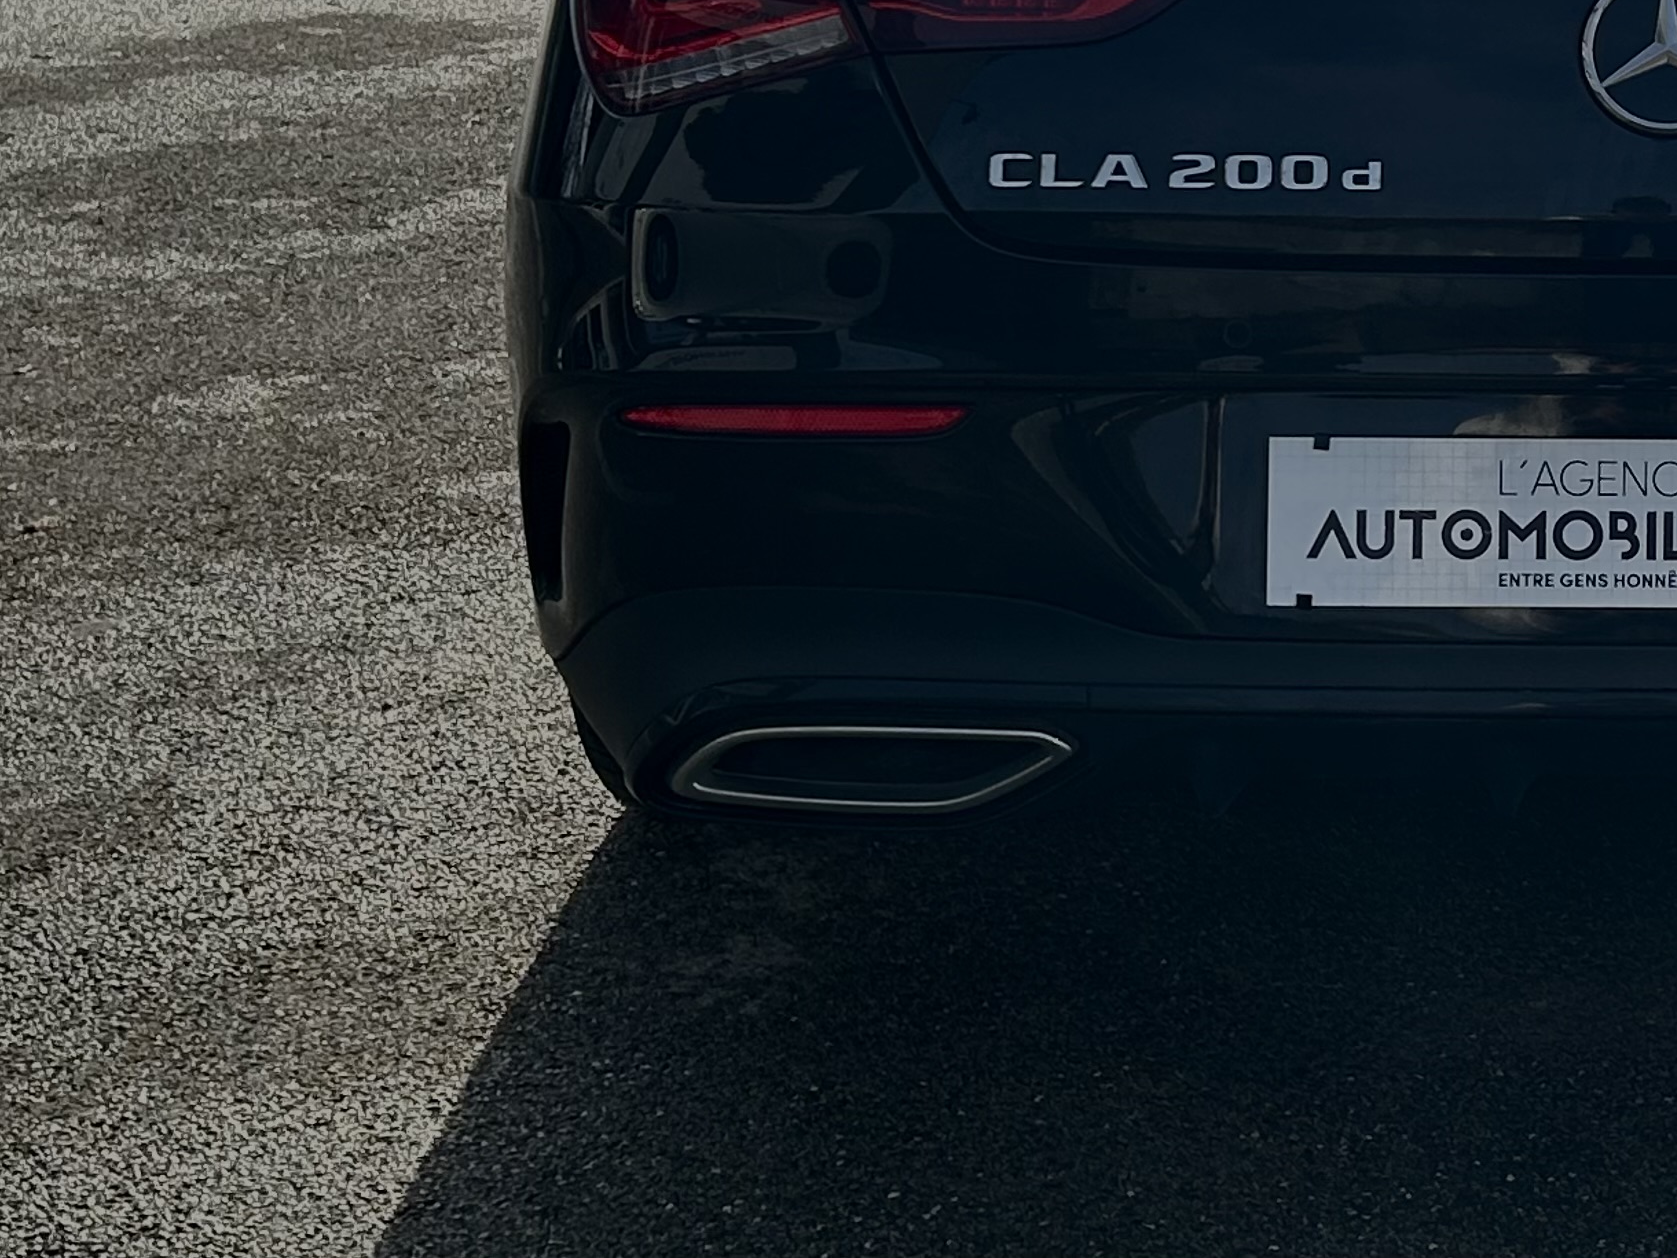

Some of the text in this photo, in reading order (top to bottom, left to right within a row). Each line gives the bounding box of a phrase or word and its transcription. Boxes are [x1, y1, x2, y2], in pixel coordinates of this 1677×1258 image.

[988, 152, 1148, 190] CLA
[1498, 572, 1554, 589] ENTRE
[1559, 572, 1609, 589] GENS
